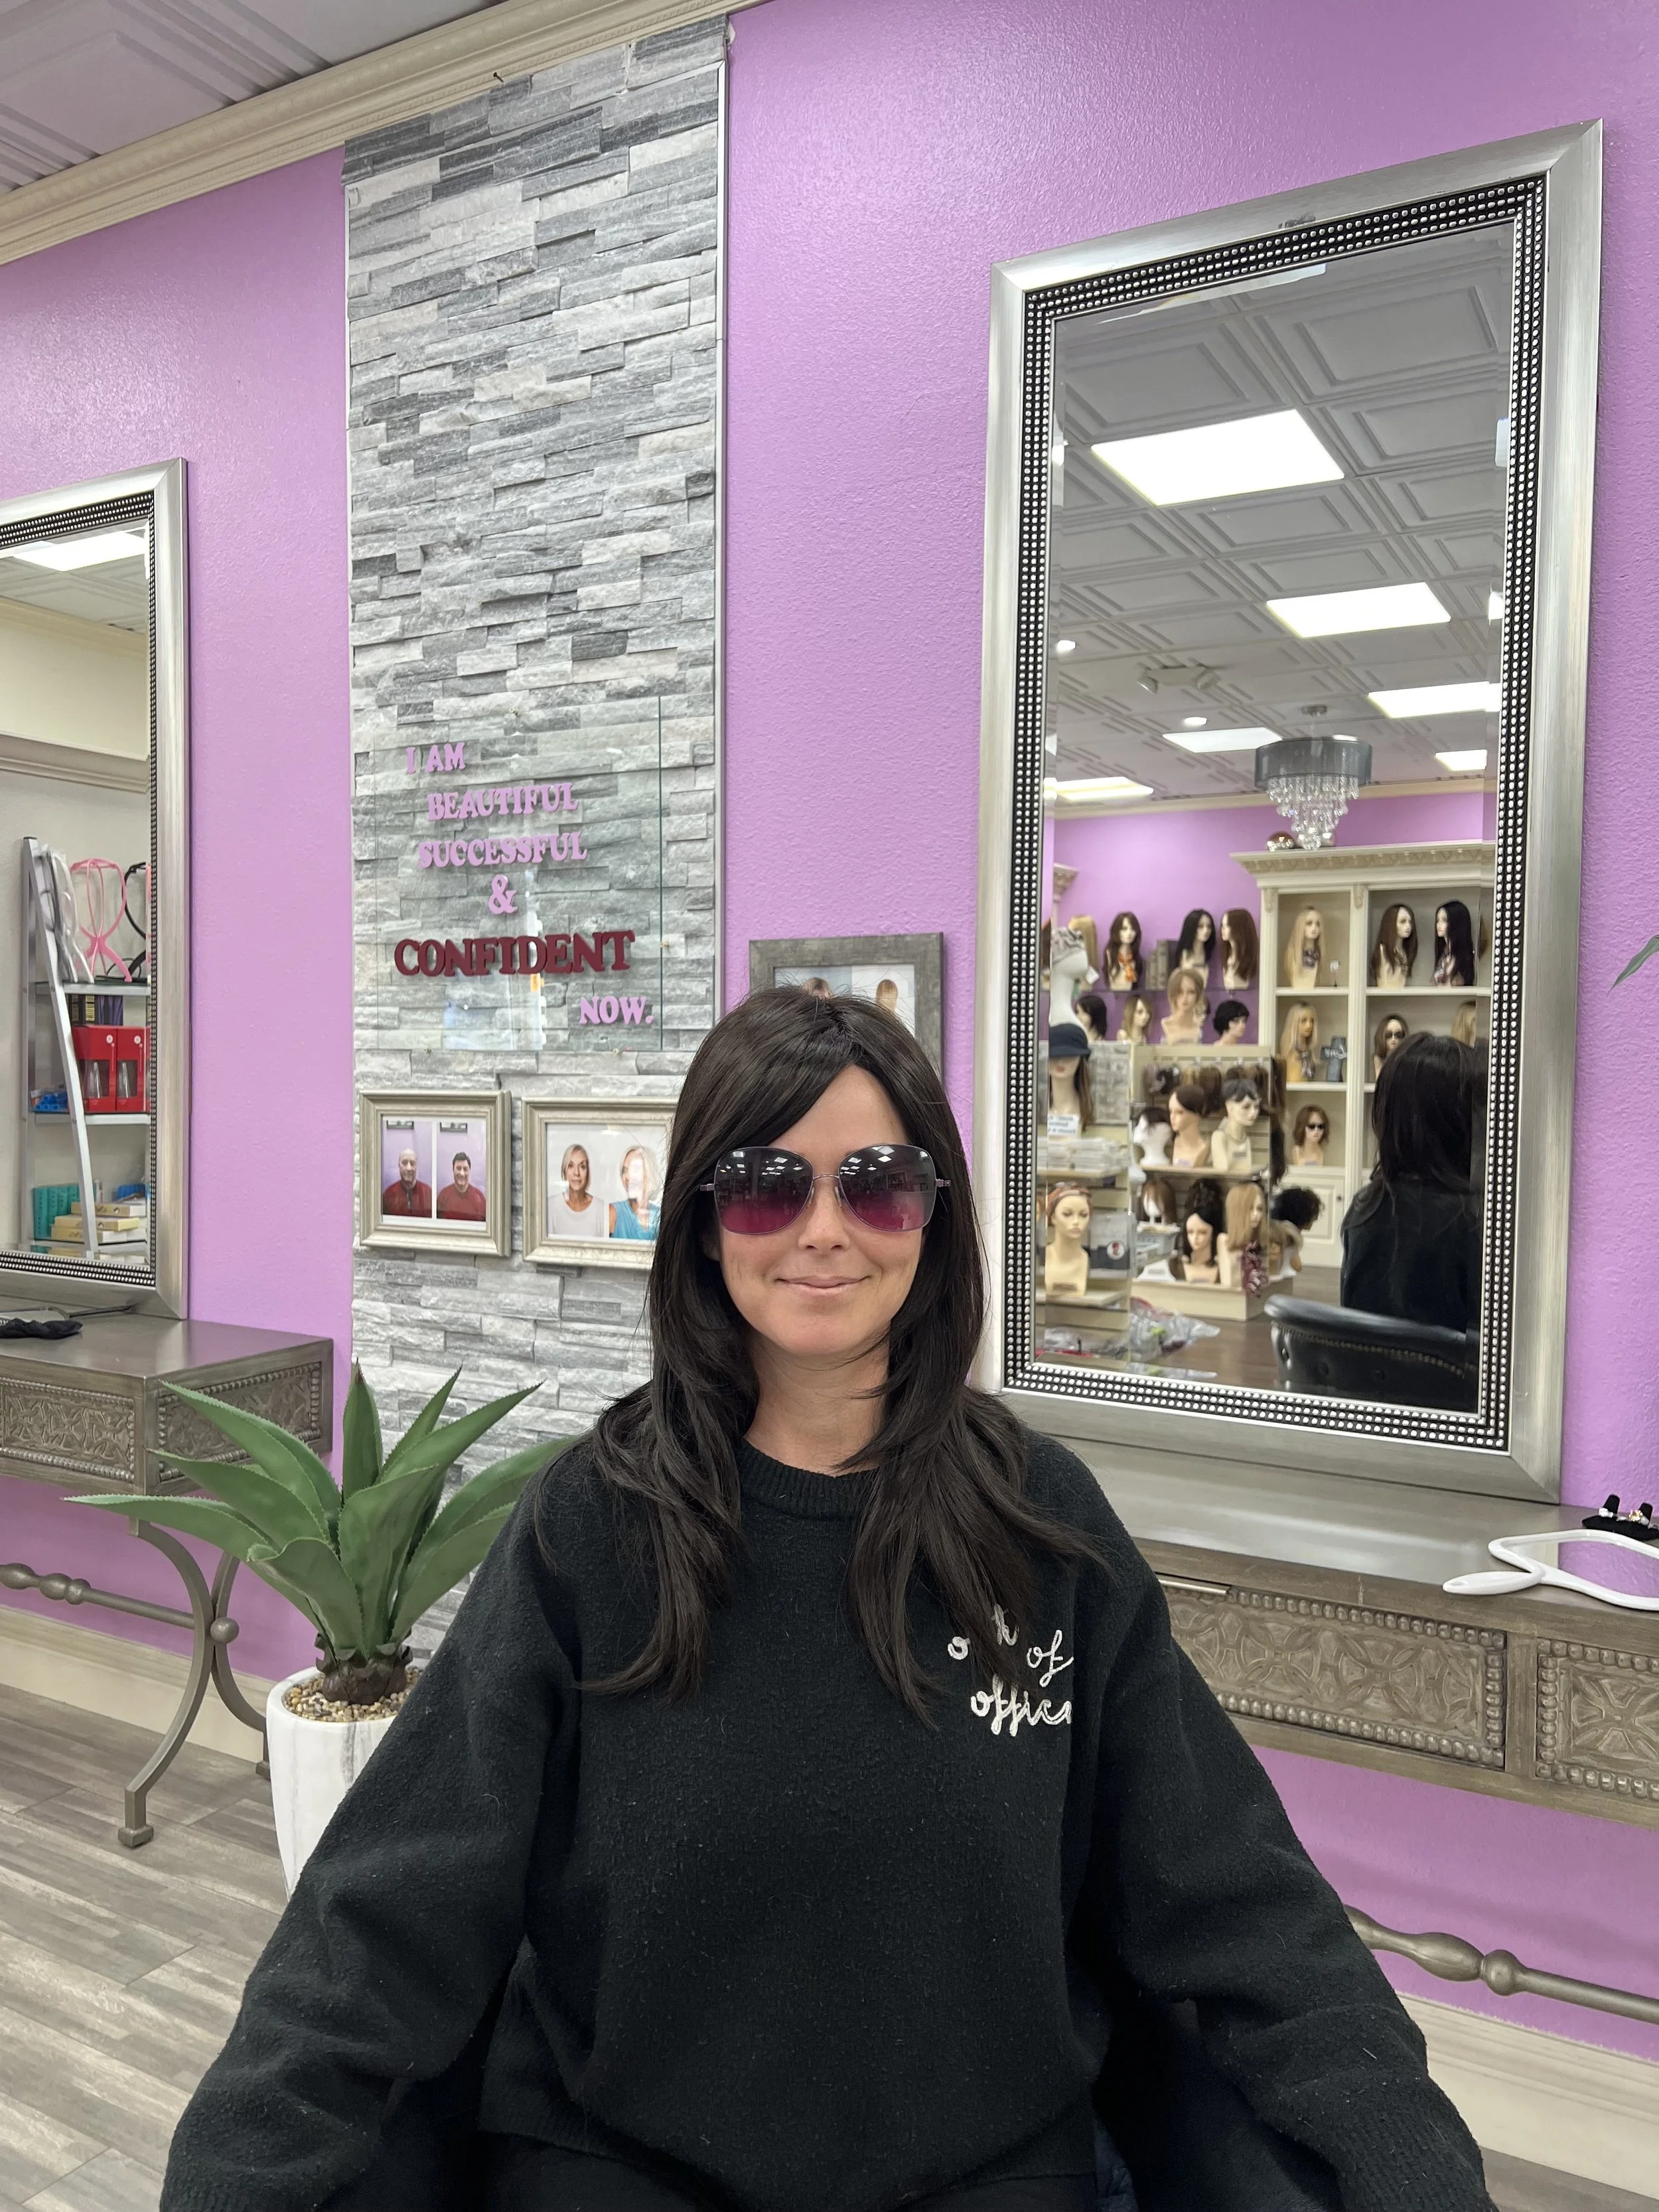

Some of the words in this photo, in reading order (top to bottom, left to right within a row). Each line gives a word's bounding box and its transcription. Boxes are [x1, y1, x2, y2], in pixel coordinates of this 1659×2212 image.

[405, 747, 416, 774] I
[425, 742, 466, 773] AM
[427, 782, 579, 821] BEAUTIFUL
[417, 832, 587, 869] SUCCESSFUL
[488, 873, 518, 915] &
[394, 930, 635, 977] CONFIDENT
[579, 995, 654, 1025] NOW.
[947, 1603, 1019, 1660] ot
[1026, 1629, 1074, 1687] of
